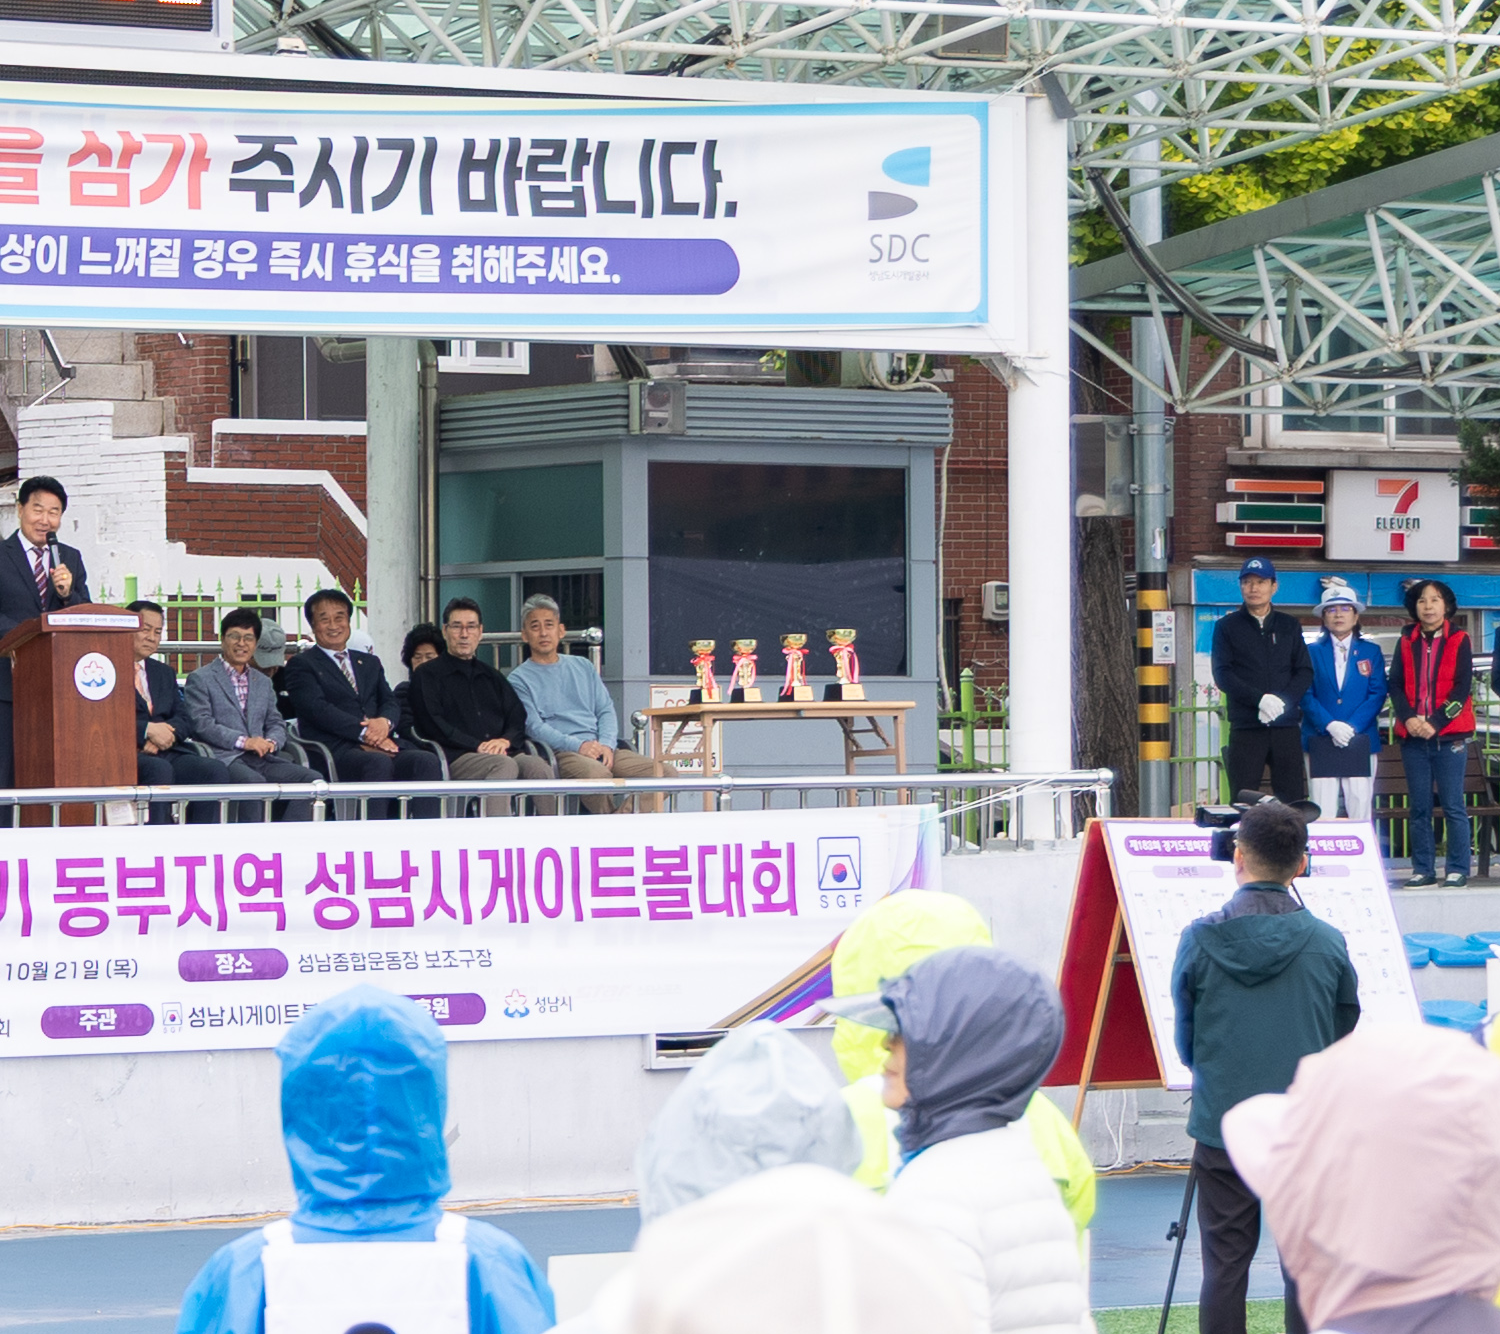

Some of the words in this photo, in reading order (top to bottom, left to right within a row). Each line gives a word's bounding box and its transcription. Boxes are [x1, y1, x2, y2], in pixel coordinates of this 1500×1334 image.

[68, 129, 211, 210] 삼가
[229, 134, 438, 216] 주시기
[459, 136, 738, 219] 바랍니다.
[79, 236, 181, 279] 느껴질
[193, 239, 258, 281] 경우
[269, 241, 333, 283] 즉시
[344, 243, 441, 284] 휴식을
[451, 245, 621, 285] 취해주세요.
[869, 233, 930, 264] SDC
[1376, 479, 1419, 554] 7
[53, 852, 287, 940] 동부지역
[306, 840, 798, 931] 성남시게이트볼대회
[5, 960, 48, 981] 10월
[54, 959, 99, 980] 21일
[106, 958, 138, 979] (목)
[215, 953, 253, 975] 장소
[298, 950, 419, 973] 성남종합운동장
[424, 948, 493, 969] 보조구장
[79, 1008, 117, 1031] 주관
[535, 995, 573, 1013] 성남시
